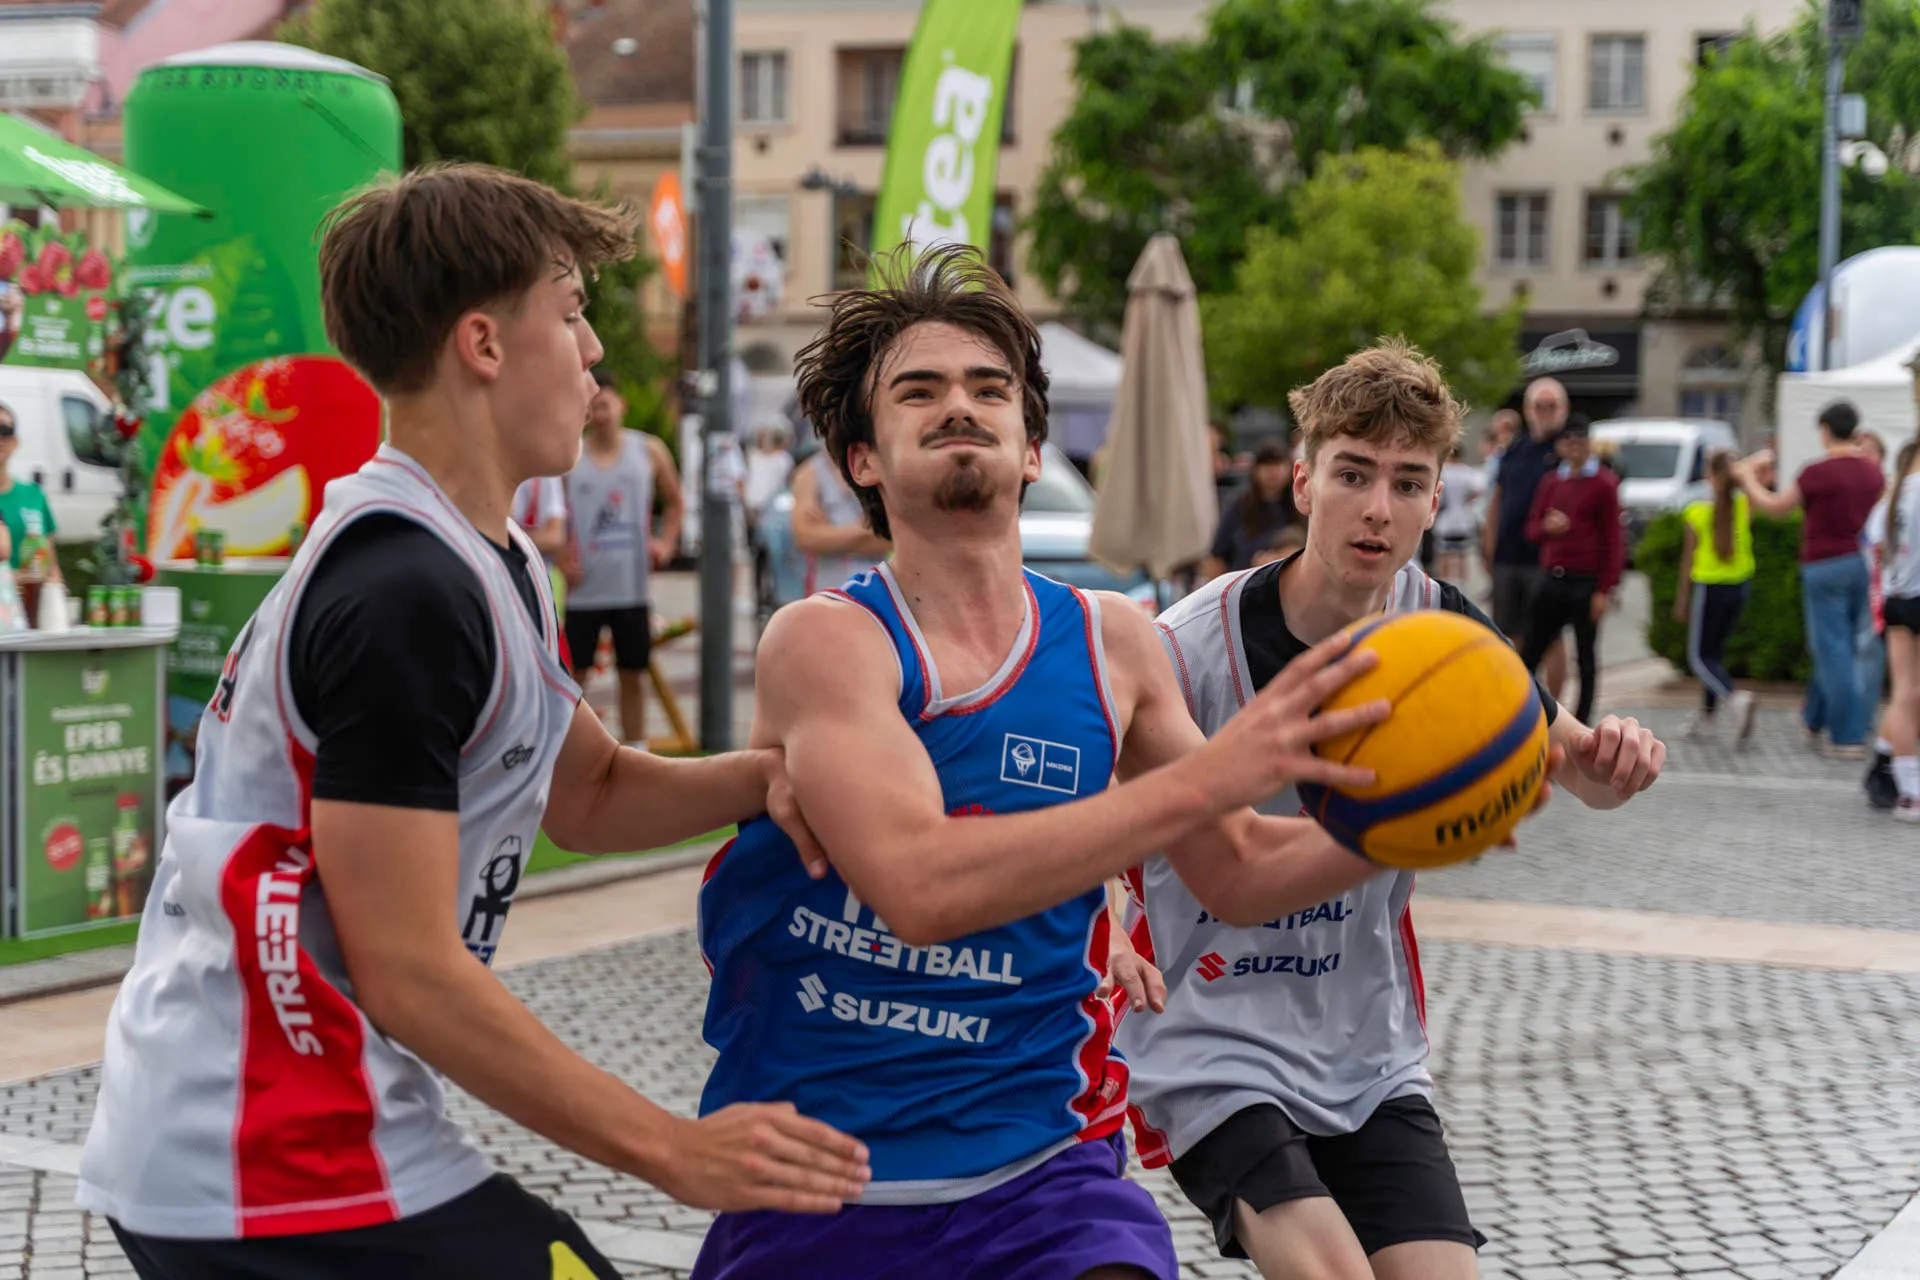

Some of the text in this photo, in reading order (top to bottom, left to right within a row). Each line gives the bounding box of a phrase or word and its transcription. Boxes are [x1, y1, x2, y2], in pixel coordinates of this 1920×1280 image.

[1435, 743, 1548, 846] molten
[788, 906, 1023, 985] STREETBALL
[1232, 952, 1341, 978] SUZUKI
[831, 992, 991, 1044] SUZUKI
